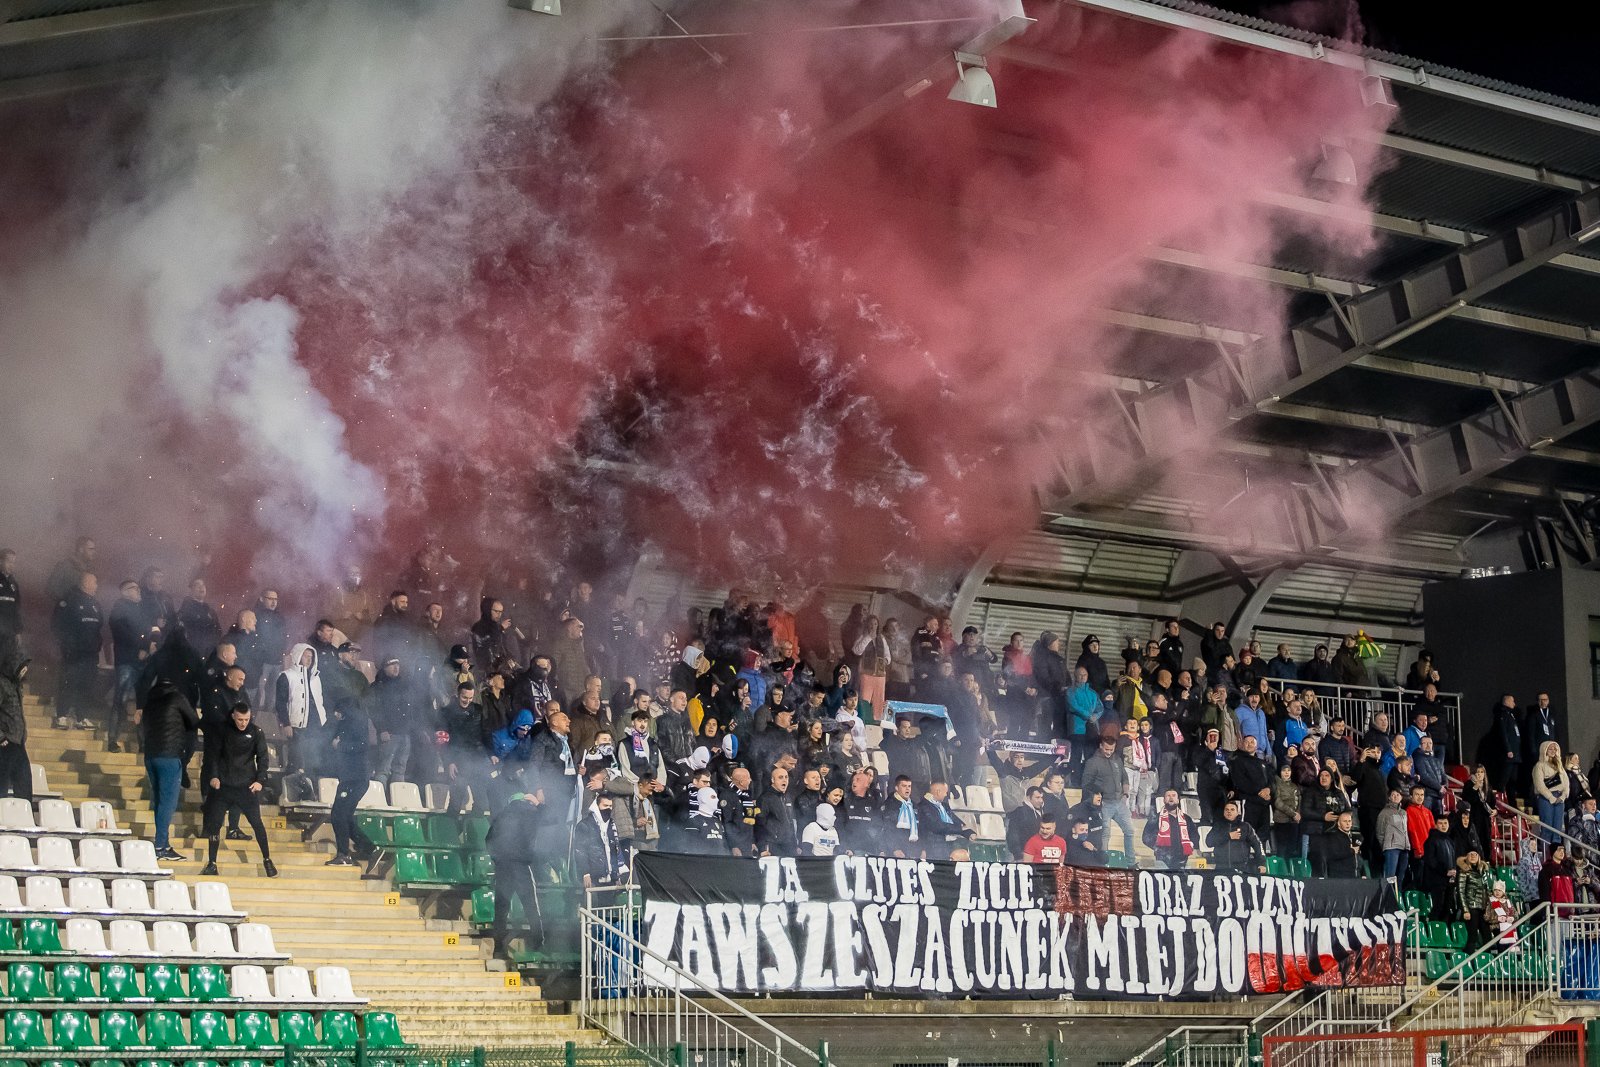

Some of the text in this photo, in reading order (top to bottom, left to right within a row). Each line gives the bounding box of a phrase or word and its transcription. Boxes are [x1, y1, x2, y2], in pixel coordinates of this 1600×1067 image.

[758, 856, 809, 902] ZA
[1138, 870, 1205, 917] ORAZ
[1213, 875, 1305, 918] BLIZNY
[447, 937, 456, 945] E2
[1084, 912, 1187, 997] MIEJ
[1191, 917, 1246, 993] DO
[508, 978, 517, 986] E1
